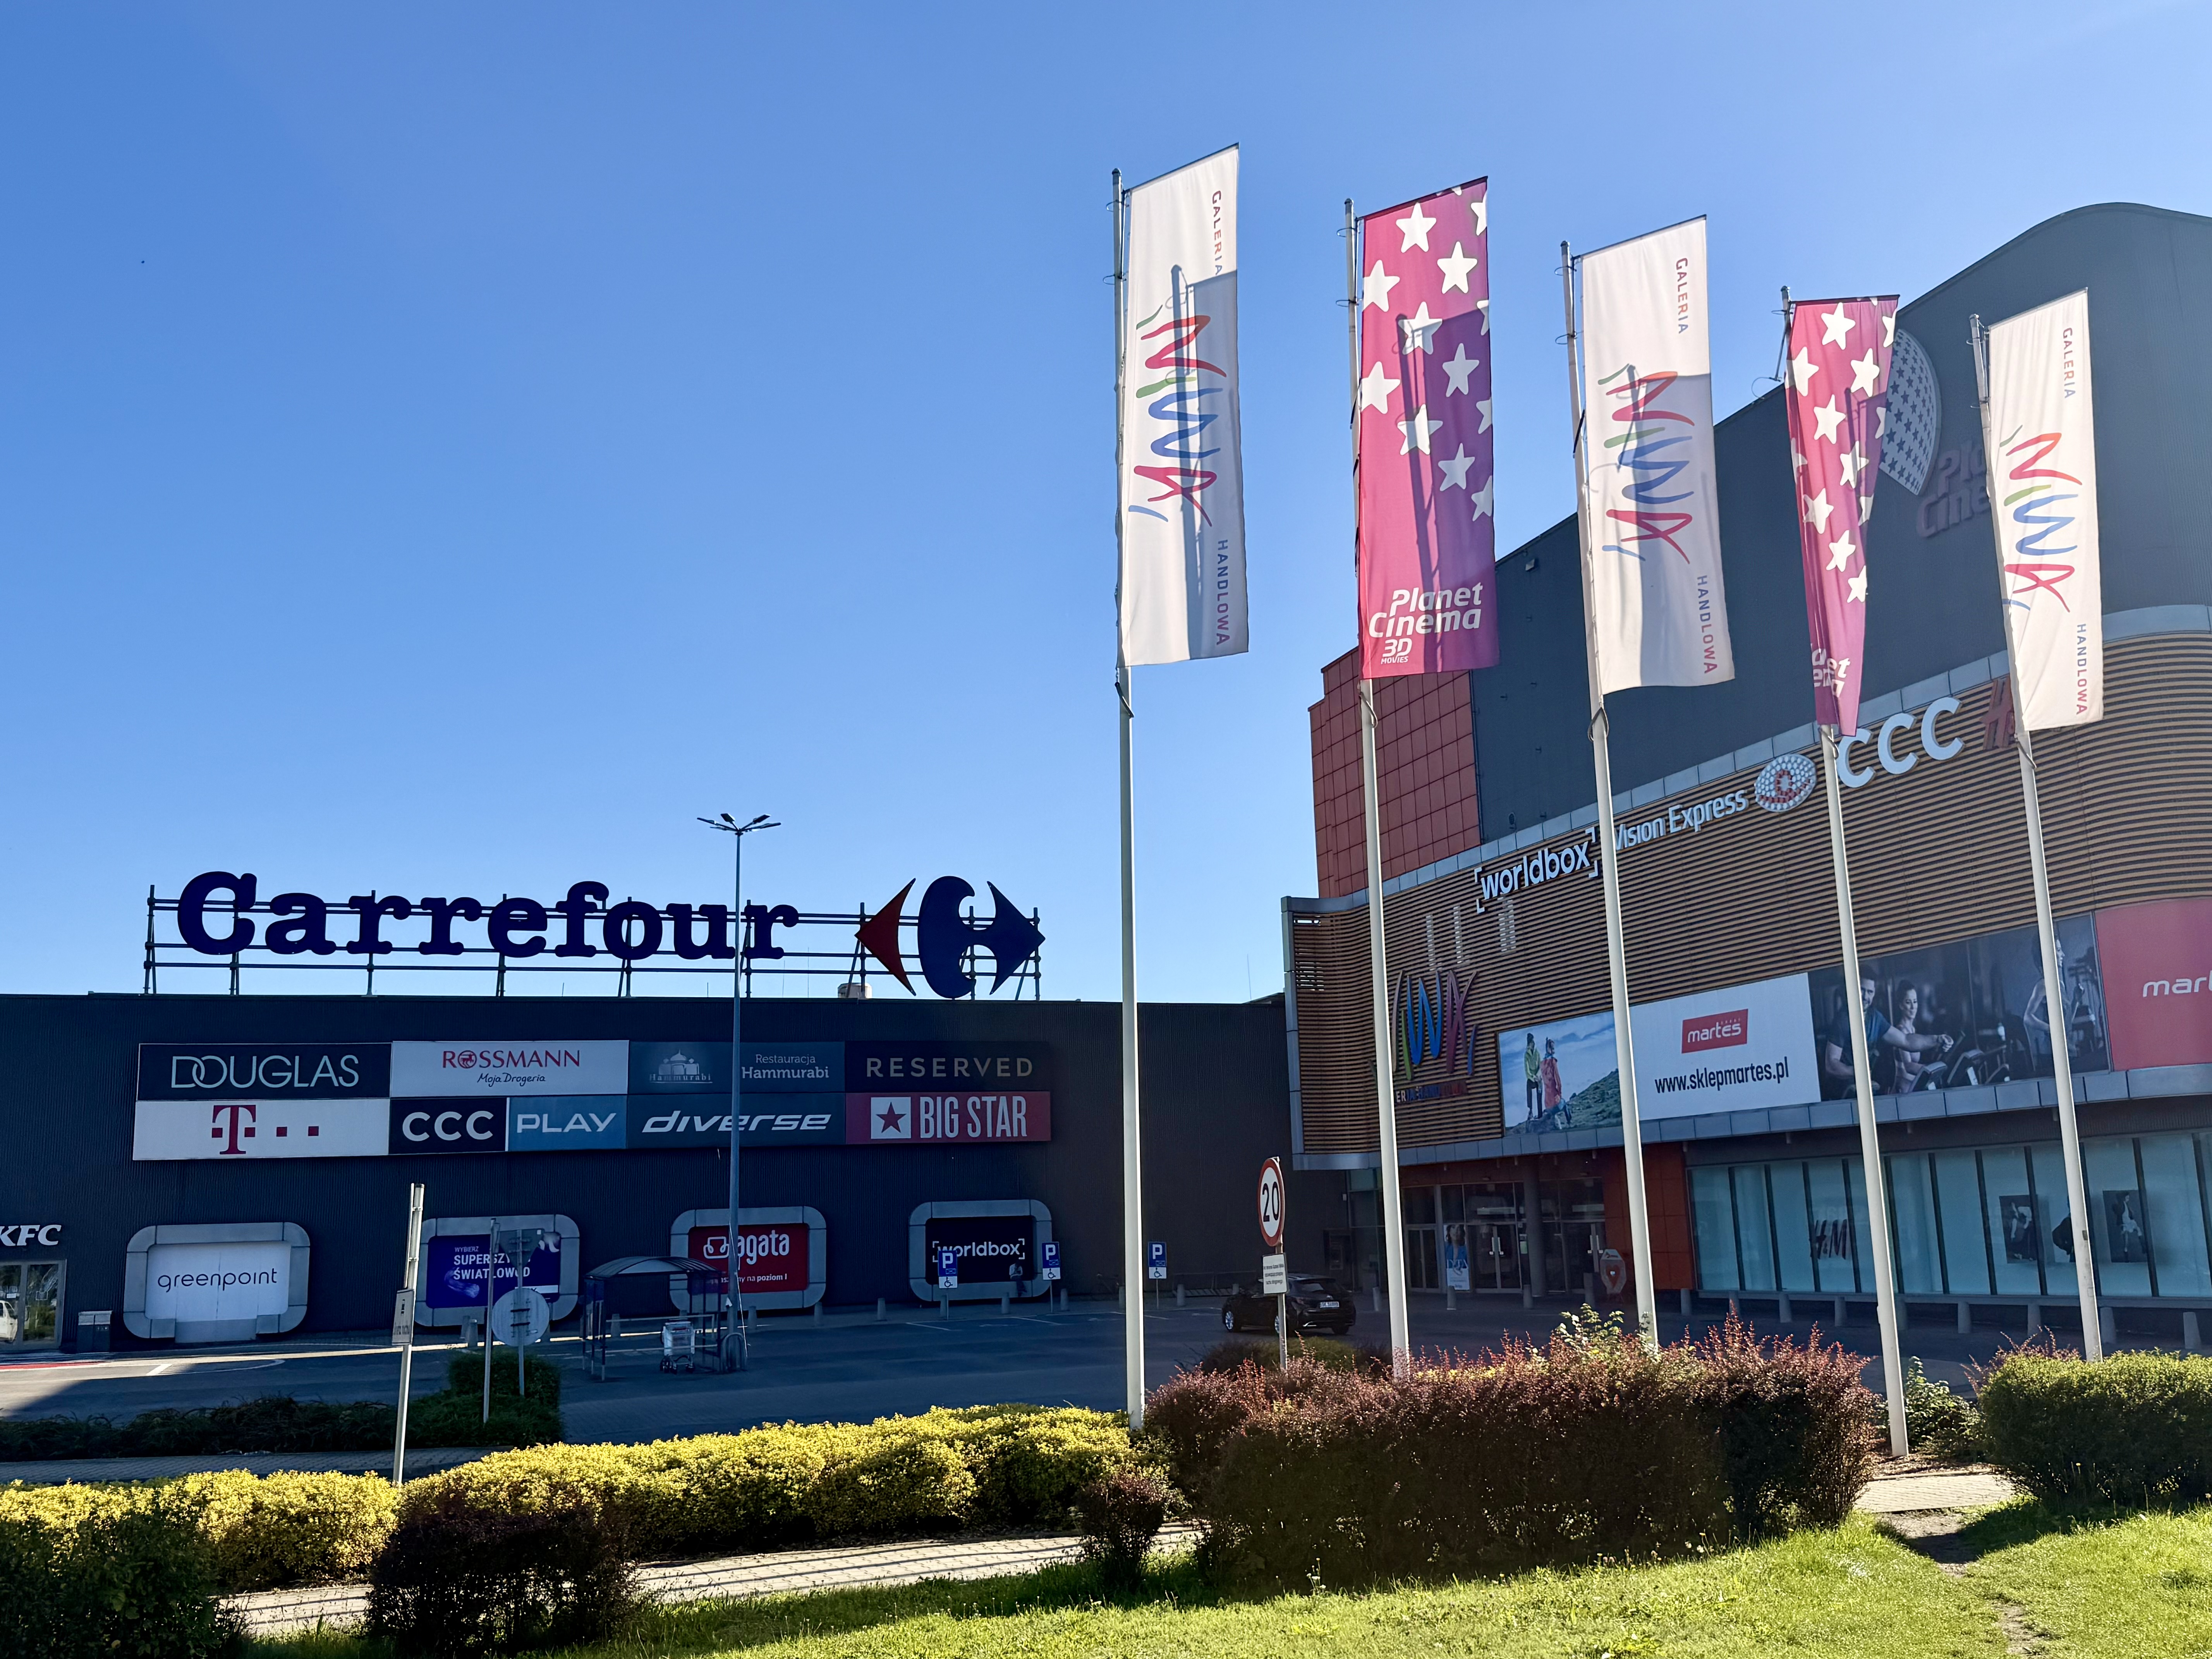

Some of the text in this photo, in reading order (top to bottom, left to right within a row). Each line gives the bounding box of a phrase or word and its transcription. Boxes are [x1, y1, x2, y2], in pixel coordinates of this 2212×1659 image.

[1212, 190, 1223, 275] GALERIA
[1676, 258, 1689, 334] GALERIA
[2063, 327, 2076, 398] GALERIA
[1216, 539, 1230, 646] HANDLOWA
[1389, 582, 1483, 617] Planet
[1369, 608, 1481, 638] Cinema
[1697, 575, 1718, 673] HANDLOWA
[1381, 655, 1409, 665] MOVIES
[1382, 638, 1412, 658] 3D
[2076, 623, 2088, 715] HANDLOWA
[1836, 697, 1965, 788] CCC
[1668, 790, 1749, 833] Express
[1480, 841, 1590, 900] worldbox
[177, 871, 799, 960] Carrefour
[1687, 1022, 1742, 1043] martes
[171, 1054, 359, 1089] DOUGLAS
[442, 1049, 580, 1069] ROSSMANN
[742, 1066, 830, 1079] Hammurabi
[756, 1054, 816, 1065] Restauracja
[866, 1058, 1033, 1077] RESERVED
[477, 1072, 546, 1087] Moja Drogeria
[649, 1073, 711, 1081] Hammurabi
[1654, 1056, 1789, 1094] www.sklepmartes.pl
[402, 1110, 494, 1142] CCC
[517, 1113, 617, 1133] PLAY
[642, 1110, 831, 1133] diverse
[920, 1096, 1027, 1139] BIG STAR
[1262, 1181, 1279, 1222] 20
[0, 1224, 62, 1246] KFC
[942, 1252, 953, 1269] P
[1045, 1244, 1056, 1261] P
[1152, 1244, 1163, 1260] P
[157, 1268, 278, 1293] greenpoint
[757, 1273, 783, 1283] poziom
